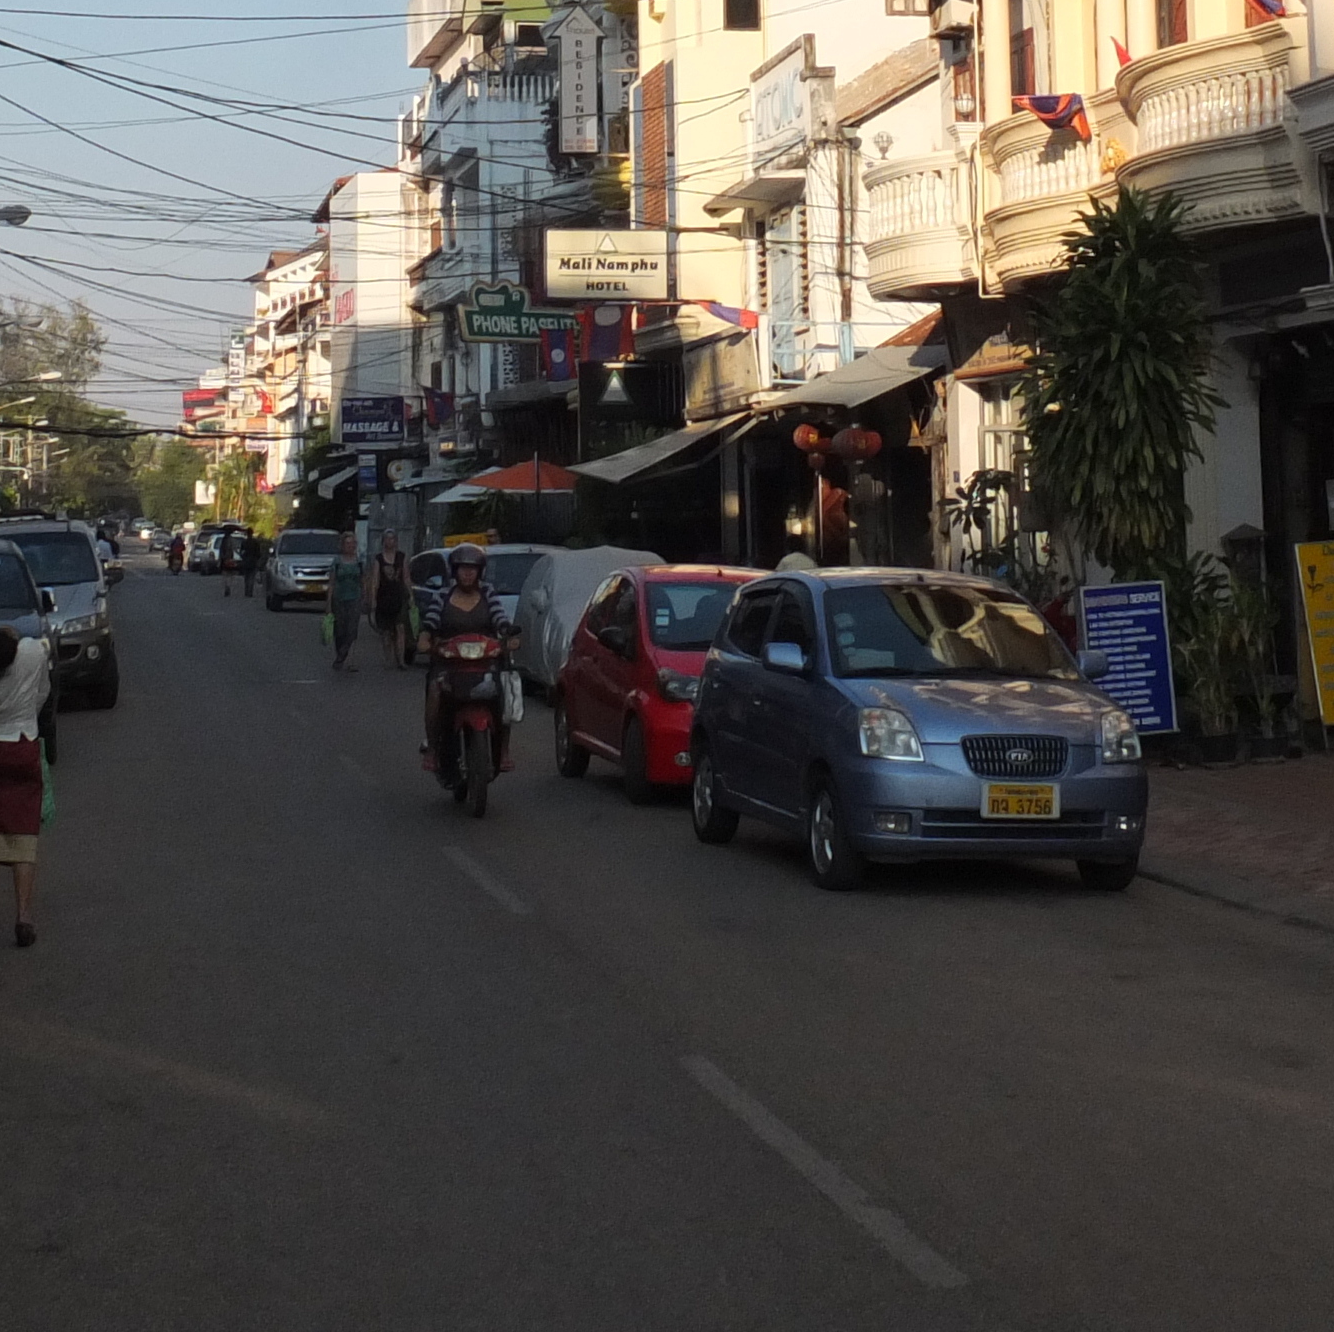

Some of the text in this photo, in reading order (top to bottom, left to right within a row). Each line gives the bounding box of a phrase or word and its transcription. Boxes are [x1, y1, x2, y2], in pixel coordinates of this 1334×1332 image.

[559, 257, 592, 270] Mali
[586, 281, 628, 291] HOTEL
[472, 314, 519, 335] PHONE
[342, 420, 390, 434] MASSAGE
[1010, 752, 1028, 762] KIA
[1016, 798, 1051, 816] 3756
